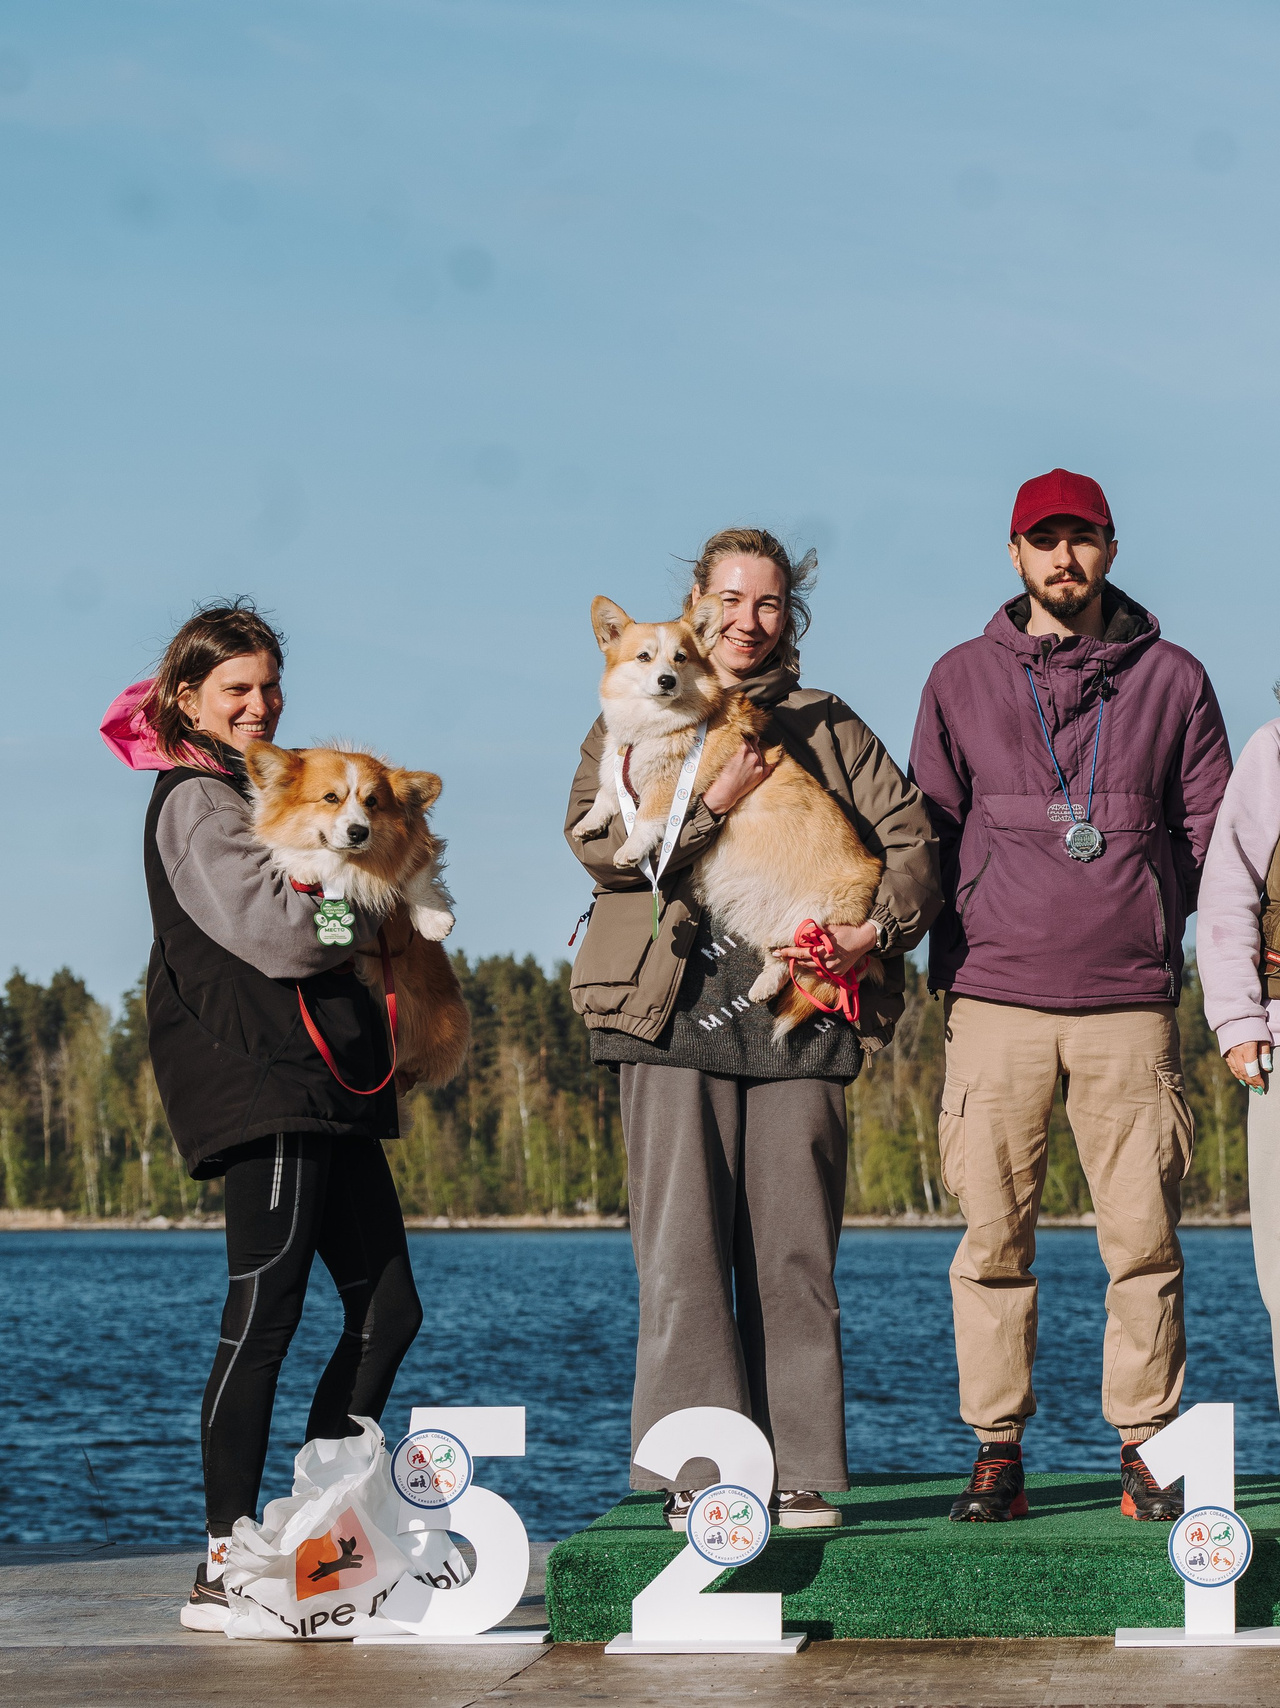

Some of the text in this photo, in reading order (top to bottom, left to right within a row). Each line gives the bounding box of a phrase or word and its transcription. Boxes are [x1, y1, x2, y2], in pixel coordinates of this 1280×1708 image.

[379, 1406, 529, 1635] 5
[633, 1406, 782, 1640] 2
[1136, 1403, 1235, 1634] 1
